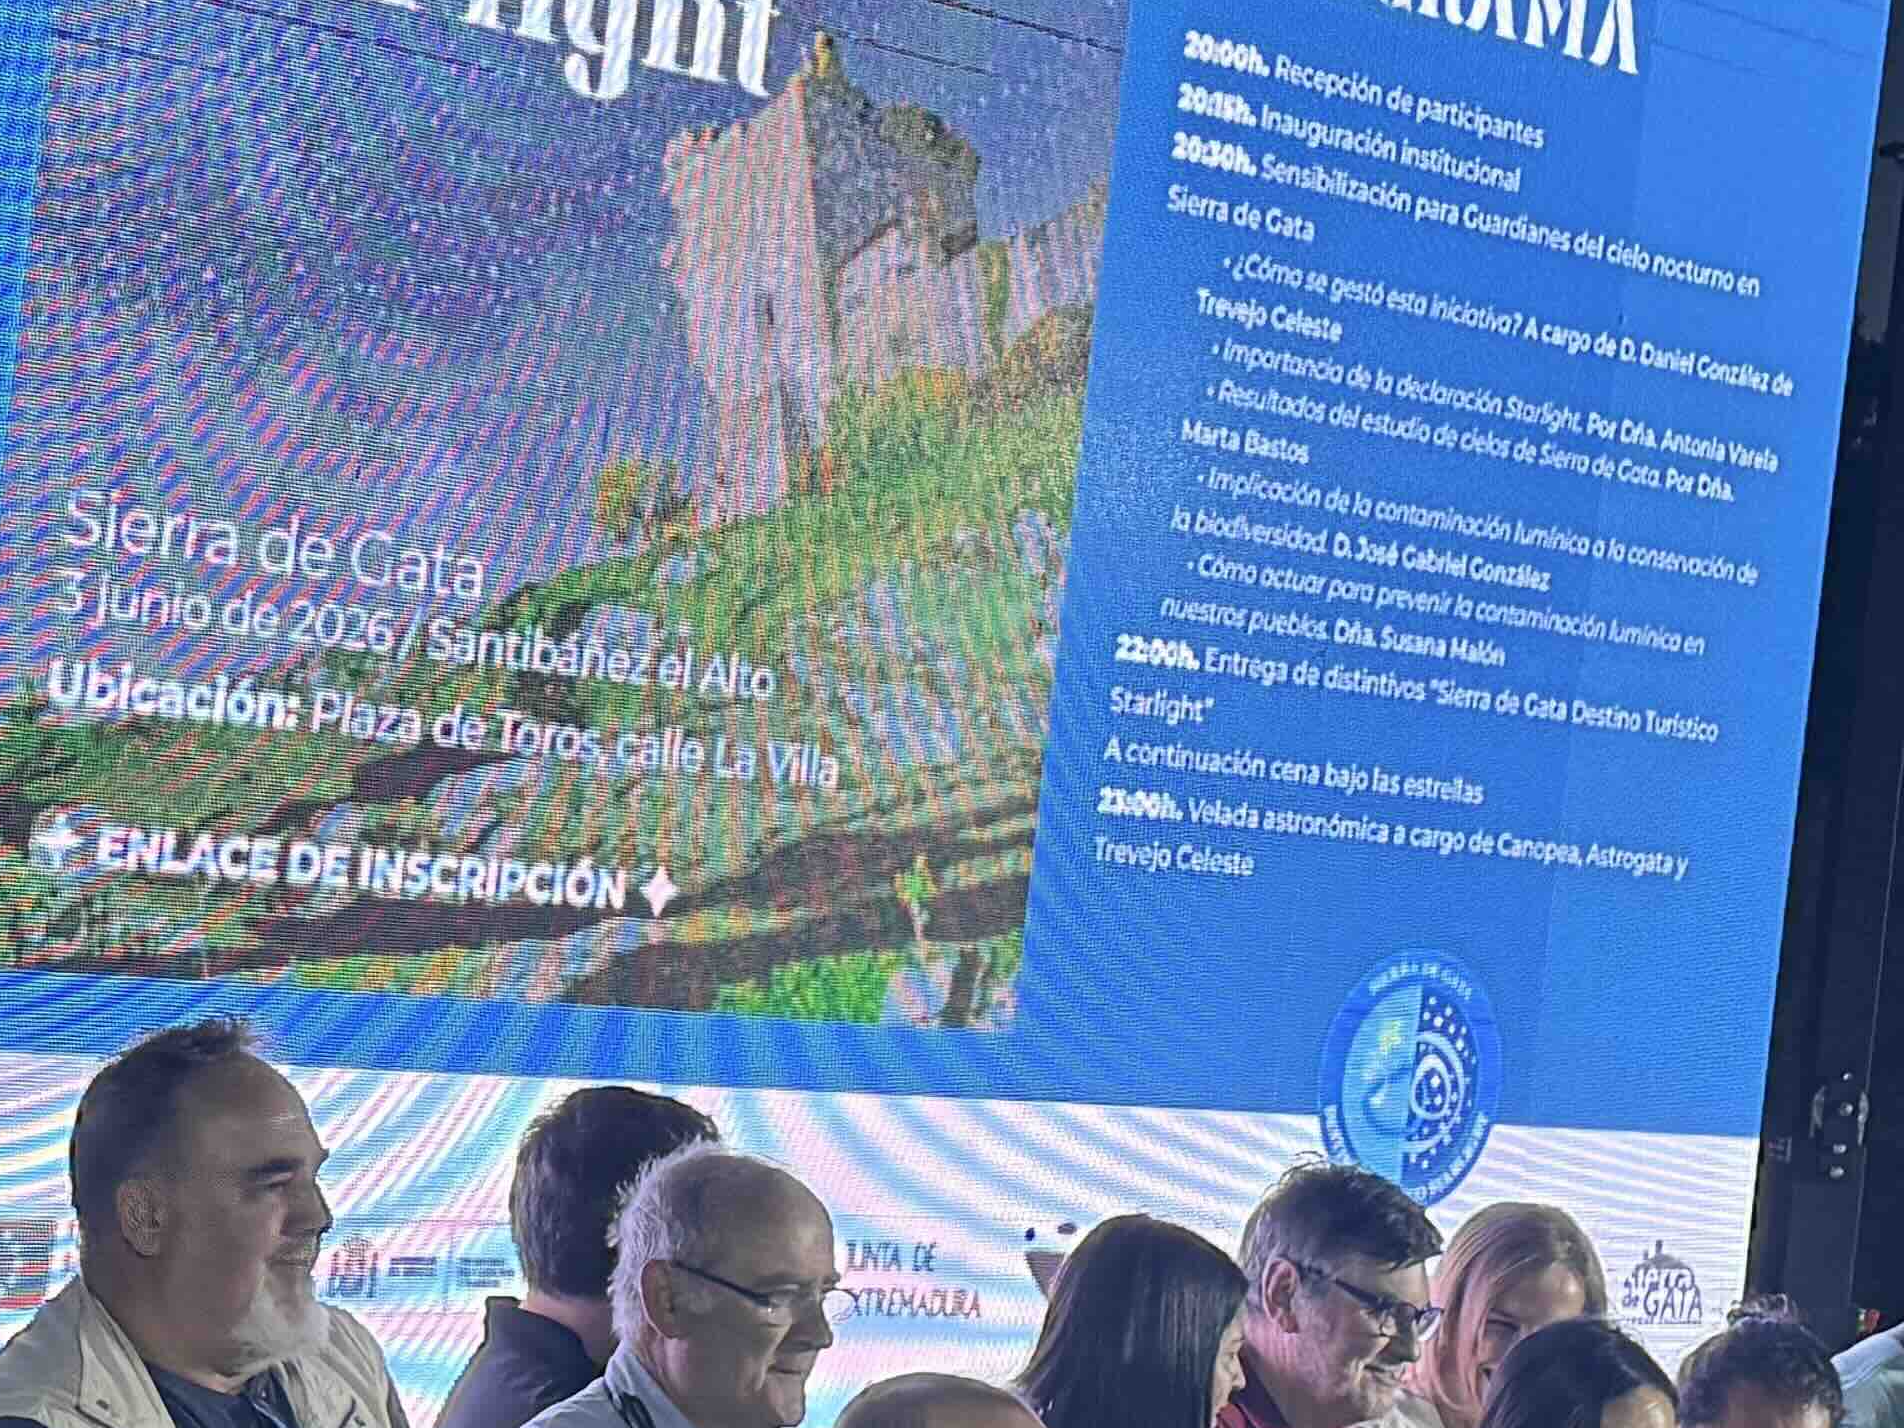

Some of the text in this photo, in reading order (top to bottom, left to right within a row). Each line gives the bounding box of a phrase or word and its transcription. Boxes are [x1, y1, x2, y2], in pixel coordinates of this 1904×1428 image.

[1273, 53, 1382, 106] Recepción
[1385, 84, 1413, 114] de
[1415, 96, 1544, 149] participantes
[1260, 103, 1396, 162] Inauguración
[1400, 137, 1521, 192] institucional
[1166, 183, 1314, 242] Sierra de Gata
[1260, 152, 1411, 213] Sensibilización
[1414, 195, 1459, 225] para
[1462, 202, 1571, 252] Guardianes
[1572, 231, 1604, 259] del
[1605, 239, 1650, 272] cielo
[1651, 254, 1734, 291] nocturno
[1736, 274, 1760, 297] en
[1196, 287, 1343, 342] Trevejo Celeste
[1304, 270, 1328, 294] se
[1329, 276, 1384, 306] gestó
[1385, 289, 1427, 316] esta
[1429, 293, 1523, 336] iniciativa?
[1523, 316, 1538, 340] A
[1540, 323, 1591, 355] cargo
[1592, 331, 1617, 357] de
[1639, 341, 1695, 375] Daniel
[1696, 354, 1769, 392] González
[1771, 372, 1793, 396] de
[1181, 418, 1309, 464] Marta Bastos
[60, 486, 488, 602] Sierra de Gata
[54, 568, 95, 618] 3
[219, 587, 282, 640] de
[287, 595, 396, 656] 2026
[423, 611, 657, 688] Santibáñez
[656, 644, 696, 692] el
[698, 649, 779, 702] Alto
[42, 651, 304, 731] Ubicación:
[309, 685, 424, 744] Plaza
[430, 698, 487, 751] de
[614, 720, 707, 775] calle
[713, 733, 760, 779] La
[767, 738, 842, 789] Villa
[1204, 645, 1288, 686] Entrega
[1291, 659, 1320, 686] de
[1323, 664, 1426, 701] distintivos
[1494, 688, 1520, 715] de
[1523, 691, 1567, 721] Gata
[1571, 699, 1641, 732] Destino
[1103, 734, 1484, 805] A continuación cena bajo las estrellas
[94, 822, 630, 911] ENLACE DE INSCRIPCIÓN
[1095, 835, 1254, 876] Trevejo Celeste
[1188, 797, 1259, 829] Velada
[1262, 809, 1389, 844] astronómica
[1392, 824, 1406, 845] a
[1409, 826, 1466, 855] cargo
[1467, 829, 1495, 855] de
[1585, 842, 1673, 876] Astrogata
[1674, 856, 1688, 881] y
